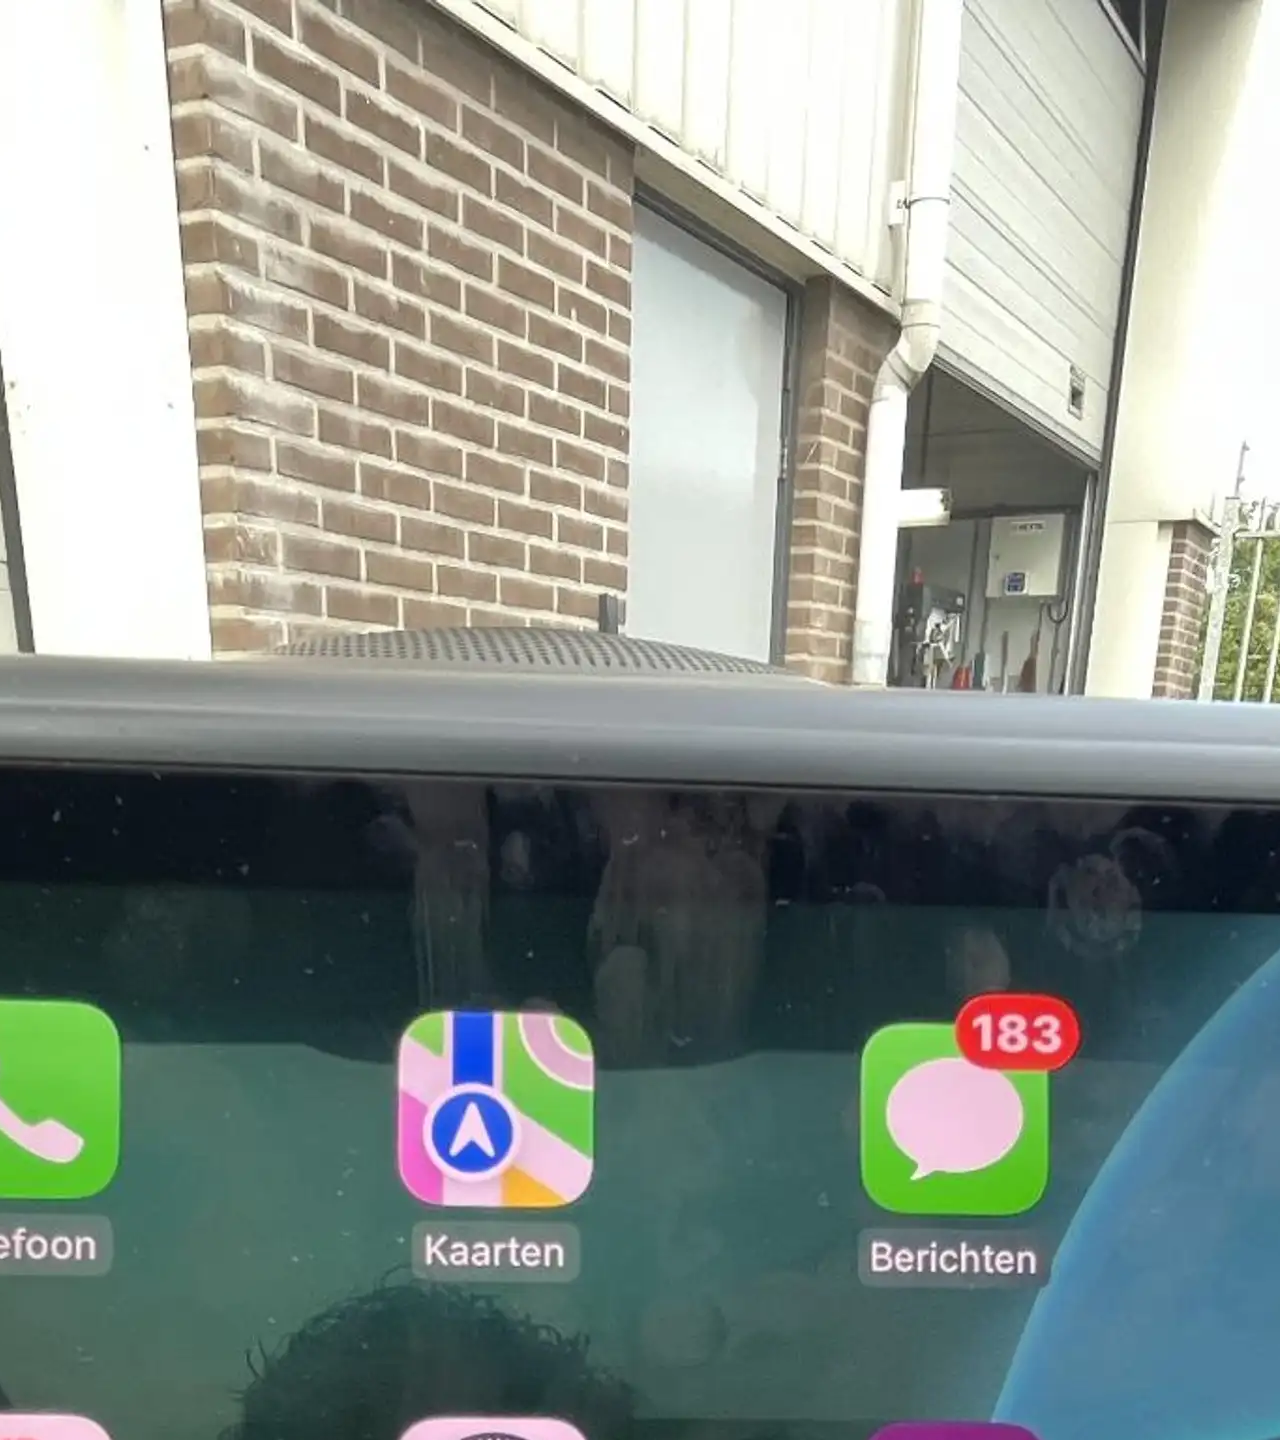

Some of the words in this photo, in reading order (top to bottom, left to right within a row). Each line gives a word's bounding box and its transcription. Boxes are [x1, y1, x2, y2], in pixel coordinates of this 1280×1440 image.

[972, 1014, 1062, 1054] 183
[425, 1235, 564, 1268] Kaarten
[870, 1242, 1037, 1275] Berichten
